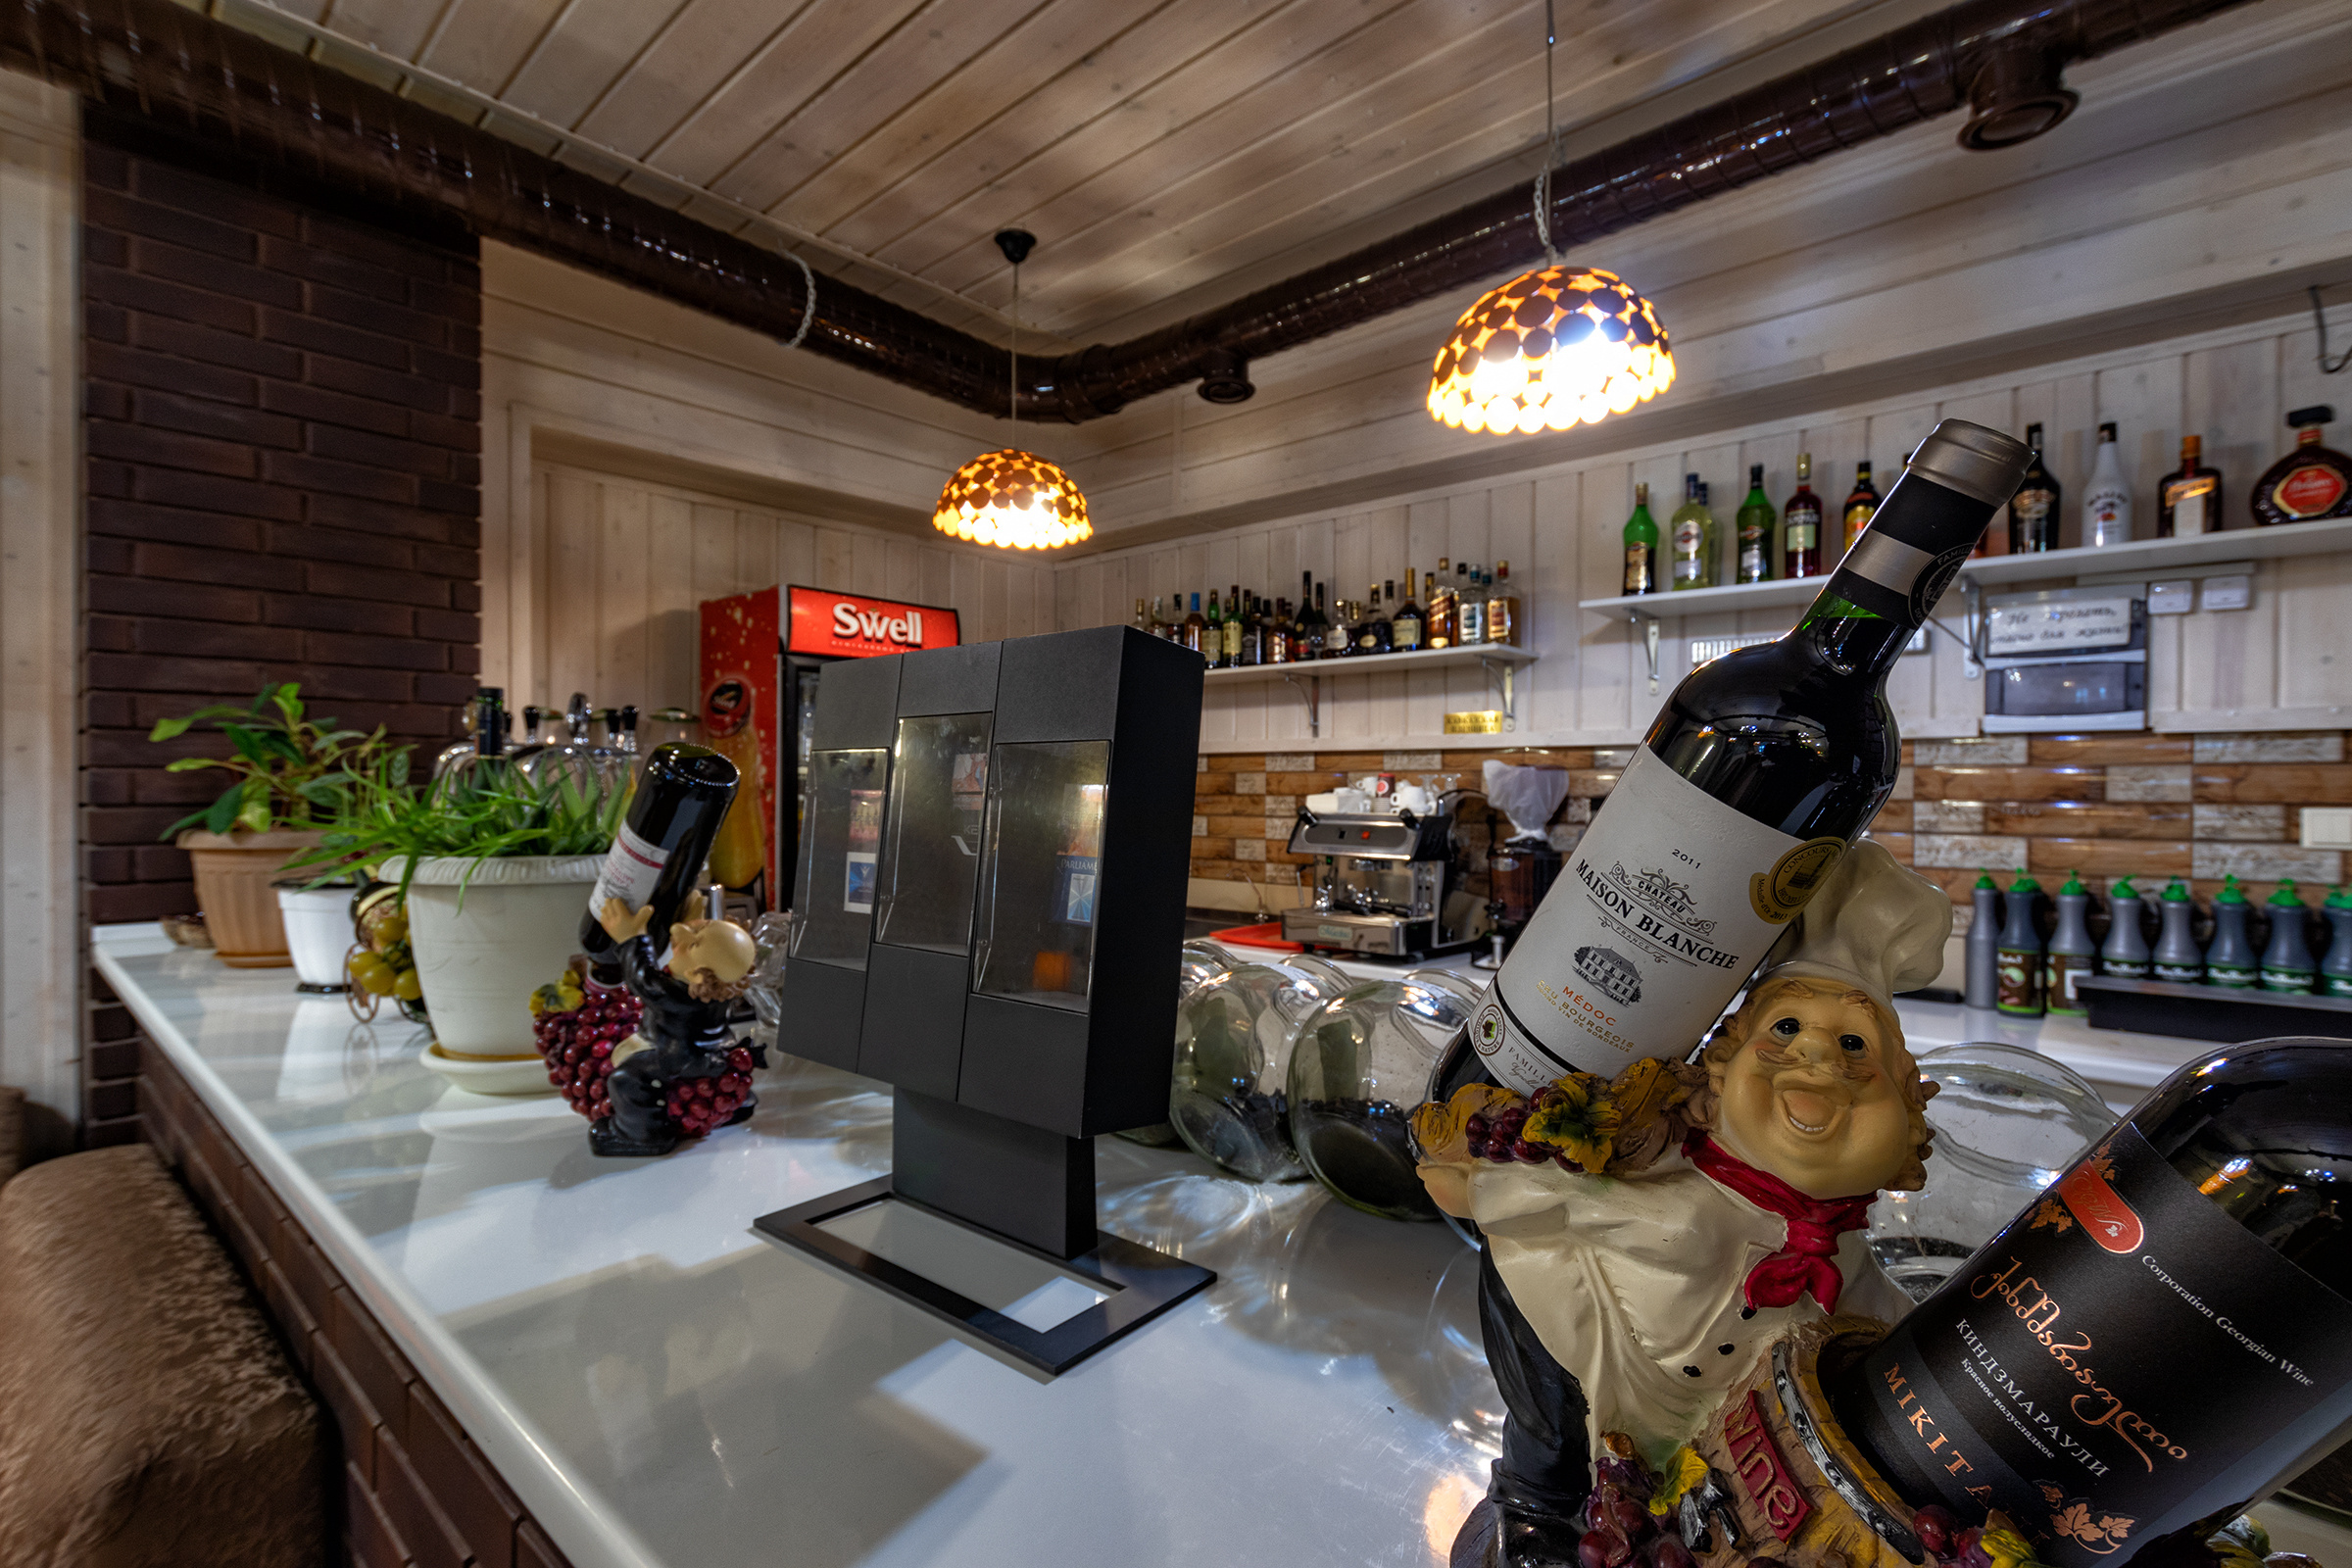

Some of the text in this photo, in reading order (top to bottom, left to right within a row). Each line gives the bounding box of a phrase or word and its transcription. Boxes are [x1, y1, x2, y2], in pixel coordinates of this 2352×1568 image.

[832, 603, 922, 644] Swell
[1671, 849, 1701, 869] 2011
[1575, 858, 1740, 970] MAISON BLANCHE
[1638, 881, 1686, 913] CHATEAU
[1617, 926, 1651, 951] FRANCE
[1538, 980, 1635, 1049] CRU BOURGEOIS
[1558, 1005, 1571, 1018] VIN
[1573, 1019, 1585, 1029] DE
[1587, 1027, 1631, 1054] BORDEAUX
[1562, 986, 1617, 1026] MÉDOC
[2142, 1255, 2314, 1387] Corporation Georgian Wine
[1955, 1318, 2111, 1478] КИНДЗМАРАУЛИ
[1961, 1357, 2055, 1459] Красное полусладкое
